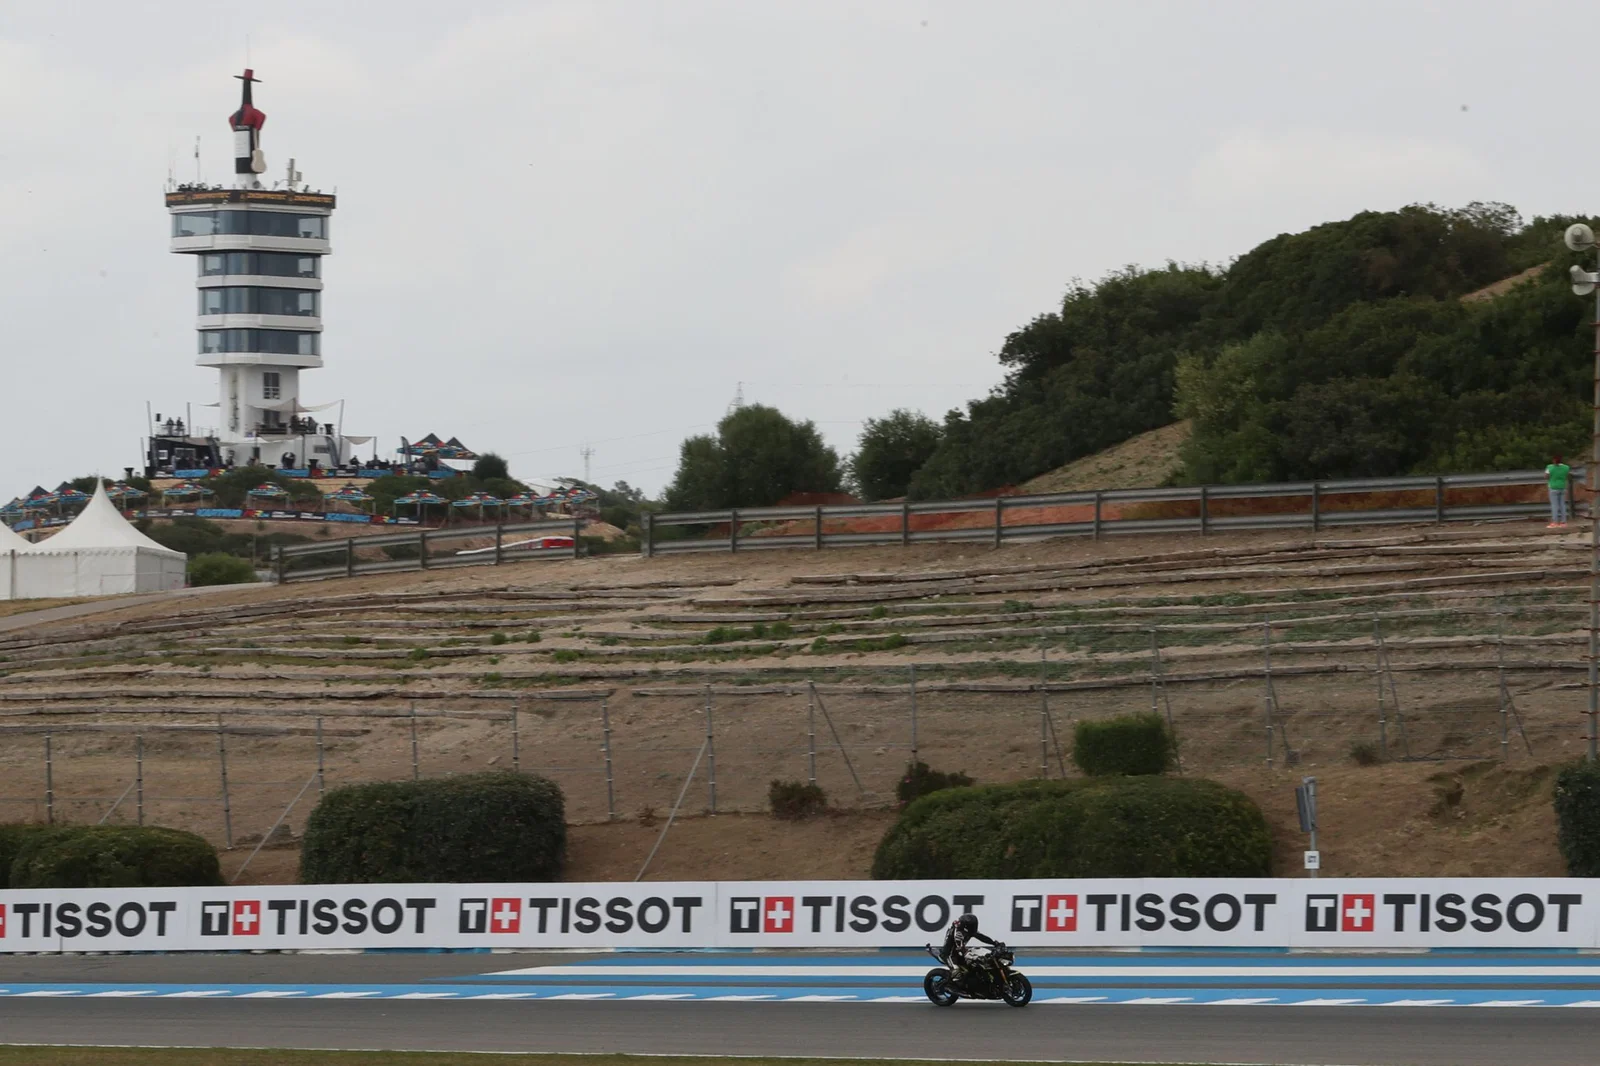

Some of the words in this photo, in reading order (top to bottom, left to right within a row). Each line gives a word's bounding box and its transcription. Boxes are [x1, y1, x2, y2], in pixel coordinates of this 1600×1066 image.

[13, 902, 176, 937] TISSOT
[268, 899, 436, 935] TISSOT
[529, 897, 702, 933] TISSOT
[802, 895, 985, 932] TISSOT
[1086, 893, 1277, 931] TISSOT
[1384, 893, 1582, 932] TISSOT
